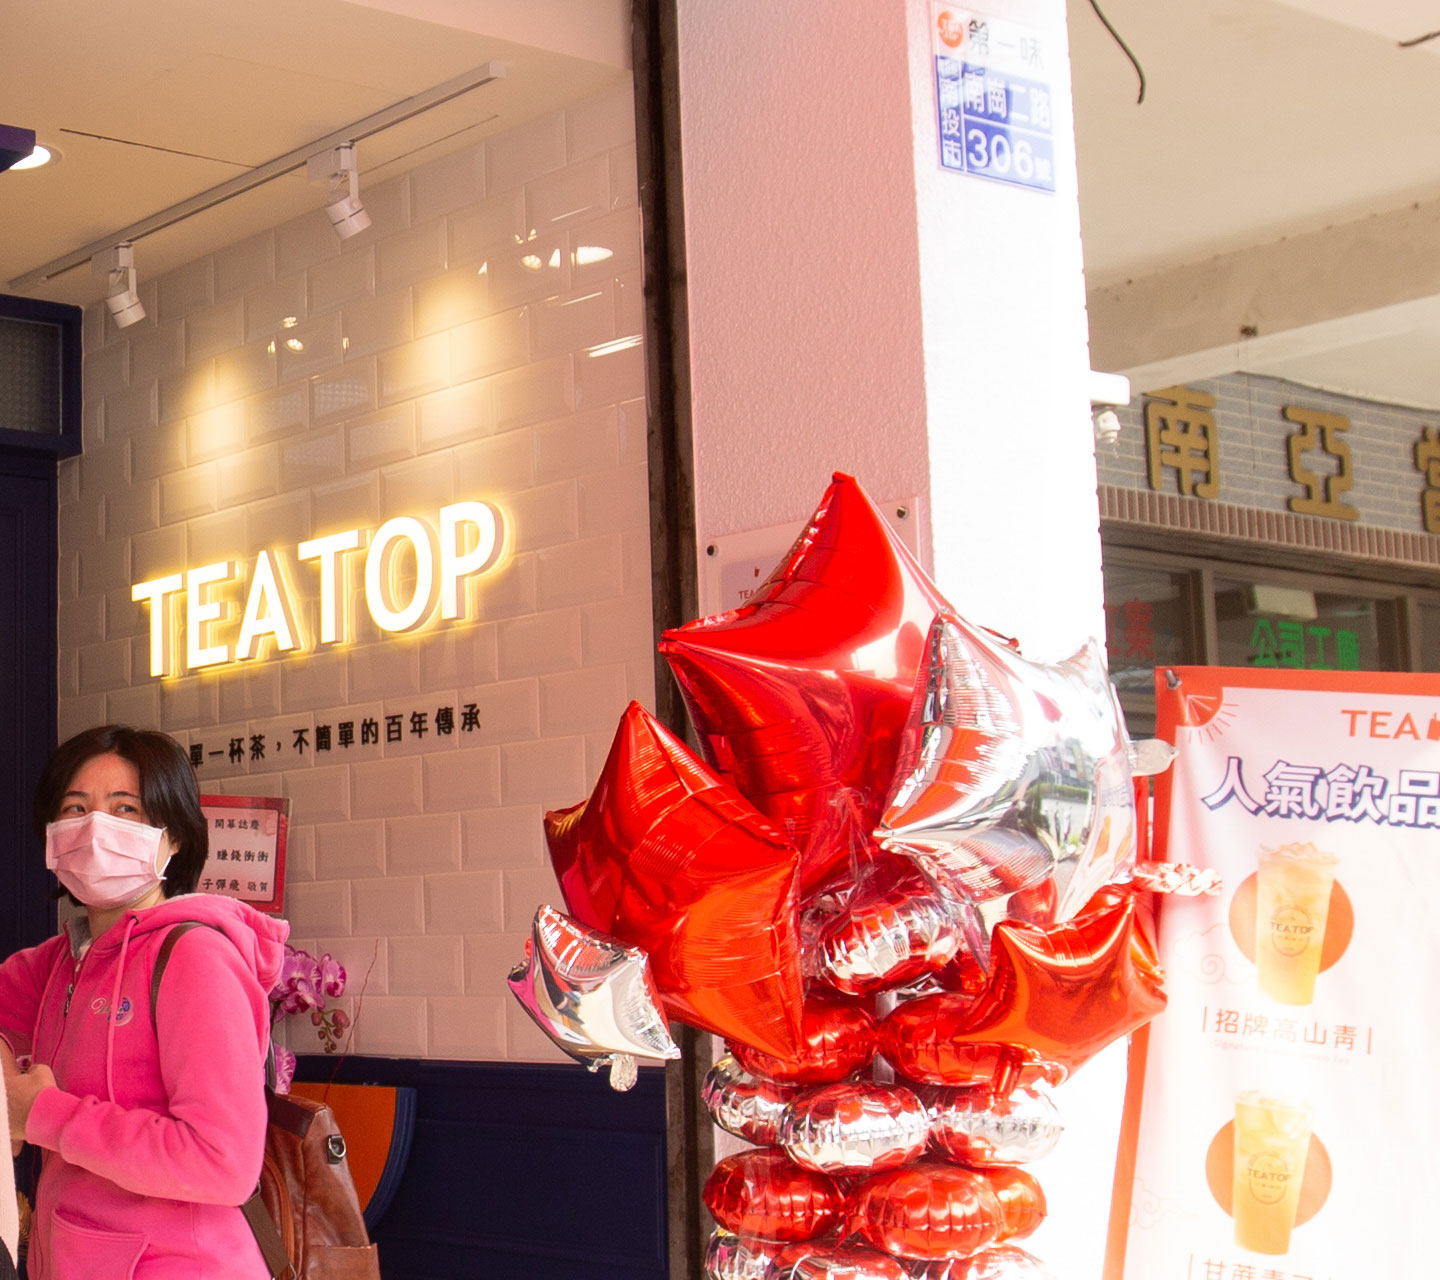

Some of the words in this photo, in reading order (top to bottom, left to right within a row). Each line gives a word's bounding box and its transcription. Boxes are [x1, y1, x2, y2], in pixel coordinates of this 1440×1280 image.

[1340, 708, 1419, 742] TEA
[1215, 1008, 1359, 1052] 招牌高山青
